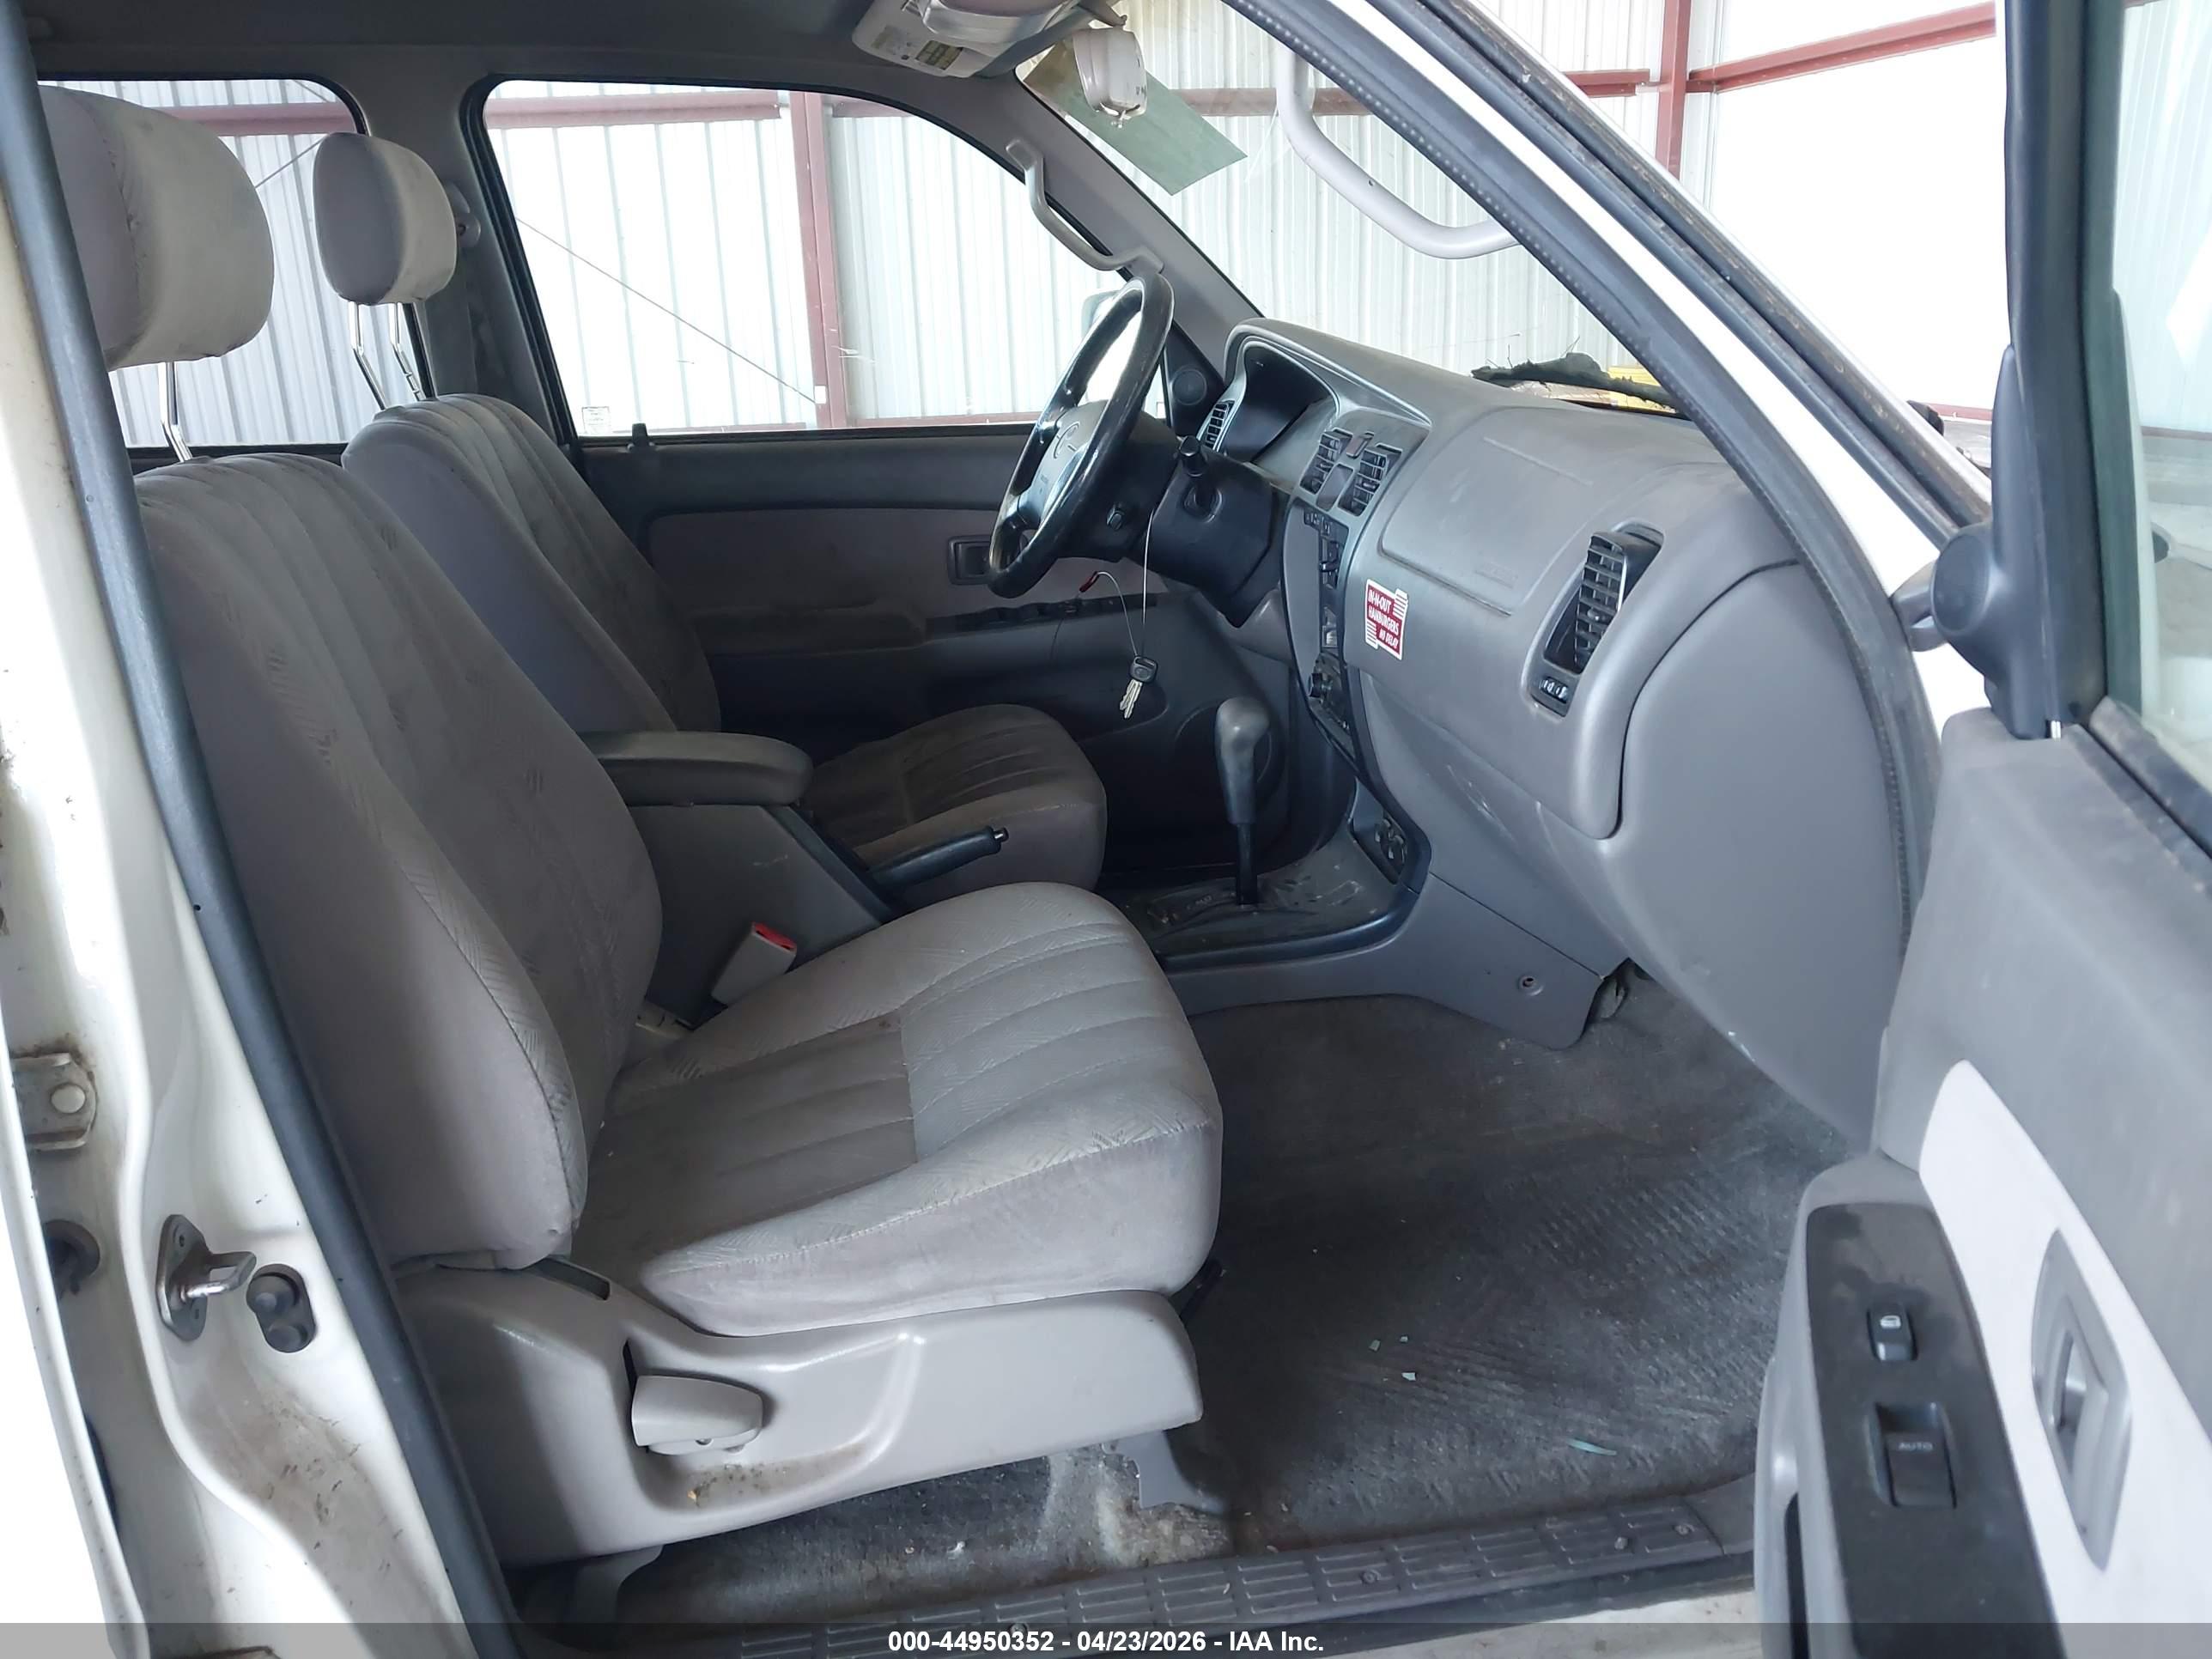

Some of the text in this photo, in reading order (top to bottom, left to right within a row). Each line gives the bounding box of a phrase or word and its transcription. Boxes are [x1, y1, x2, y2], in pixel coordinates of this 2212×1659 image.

[1368, 589, 1391, 614] IN-N-OUT
[1368, 605, 1400, 635] HAMBURGERS
[1378, 628, 1399, 649] NO DELAY
[1898, 1442, 1933, 1452] AUTO
